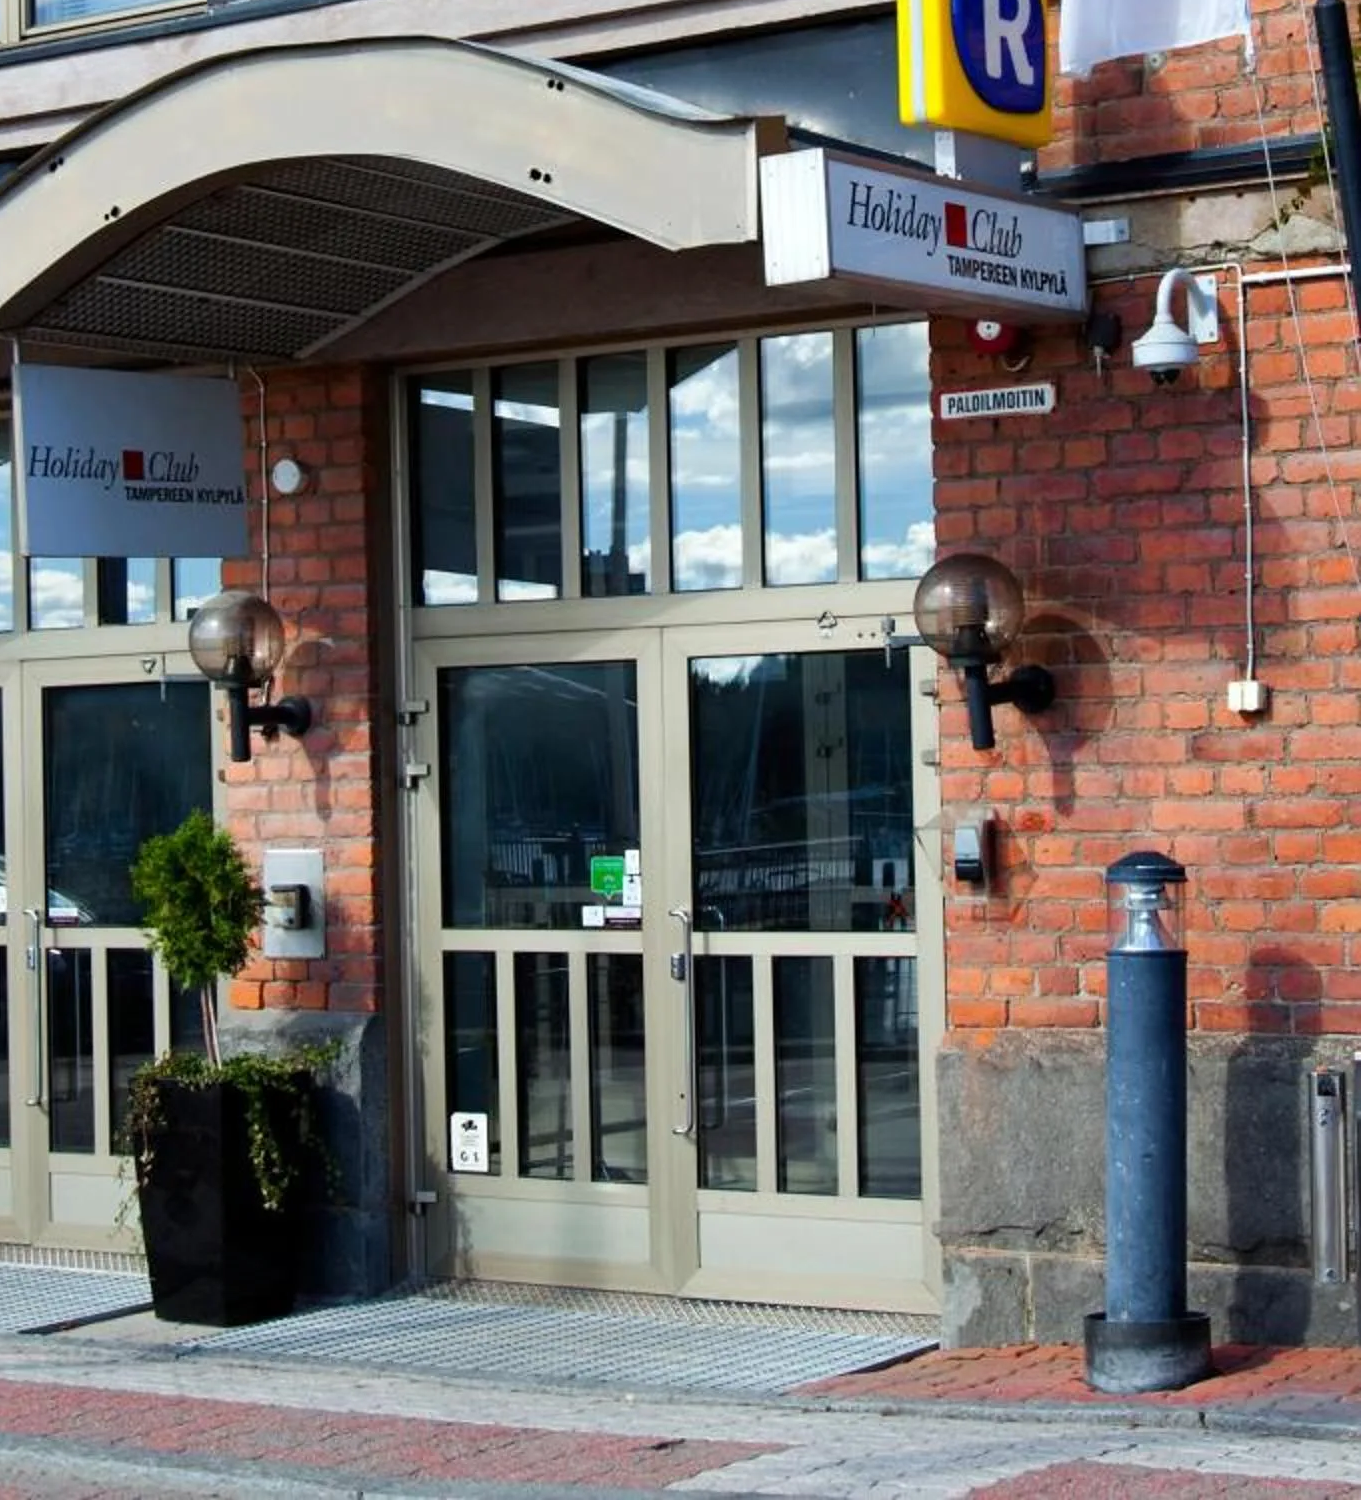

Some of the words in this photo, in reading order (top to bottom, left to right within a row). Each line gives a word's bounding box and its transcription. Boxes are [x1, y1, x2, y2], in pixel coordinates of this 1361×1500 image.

[846, 180, 943, 257] Holiday
[971, 207, 1024, 259] Club
[946, 253, 1019, 290] TAMPEREEN
[1019, 267, 1069, 297] KYLPYLÄ
[947, 387, 1047, 415] PALOILMOITIN
[28, 445, 120, 491] Holiday
[148, 451, 200, 483] Club
[124, 485, 194, 503] TAMPEREEN
